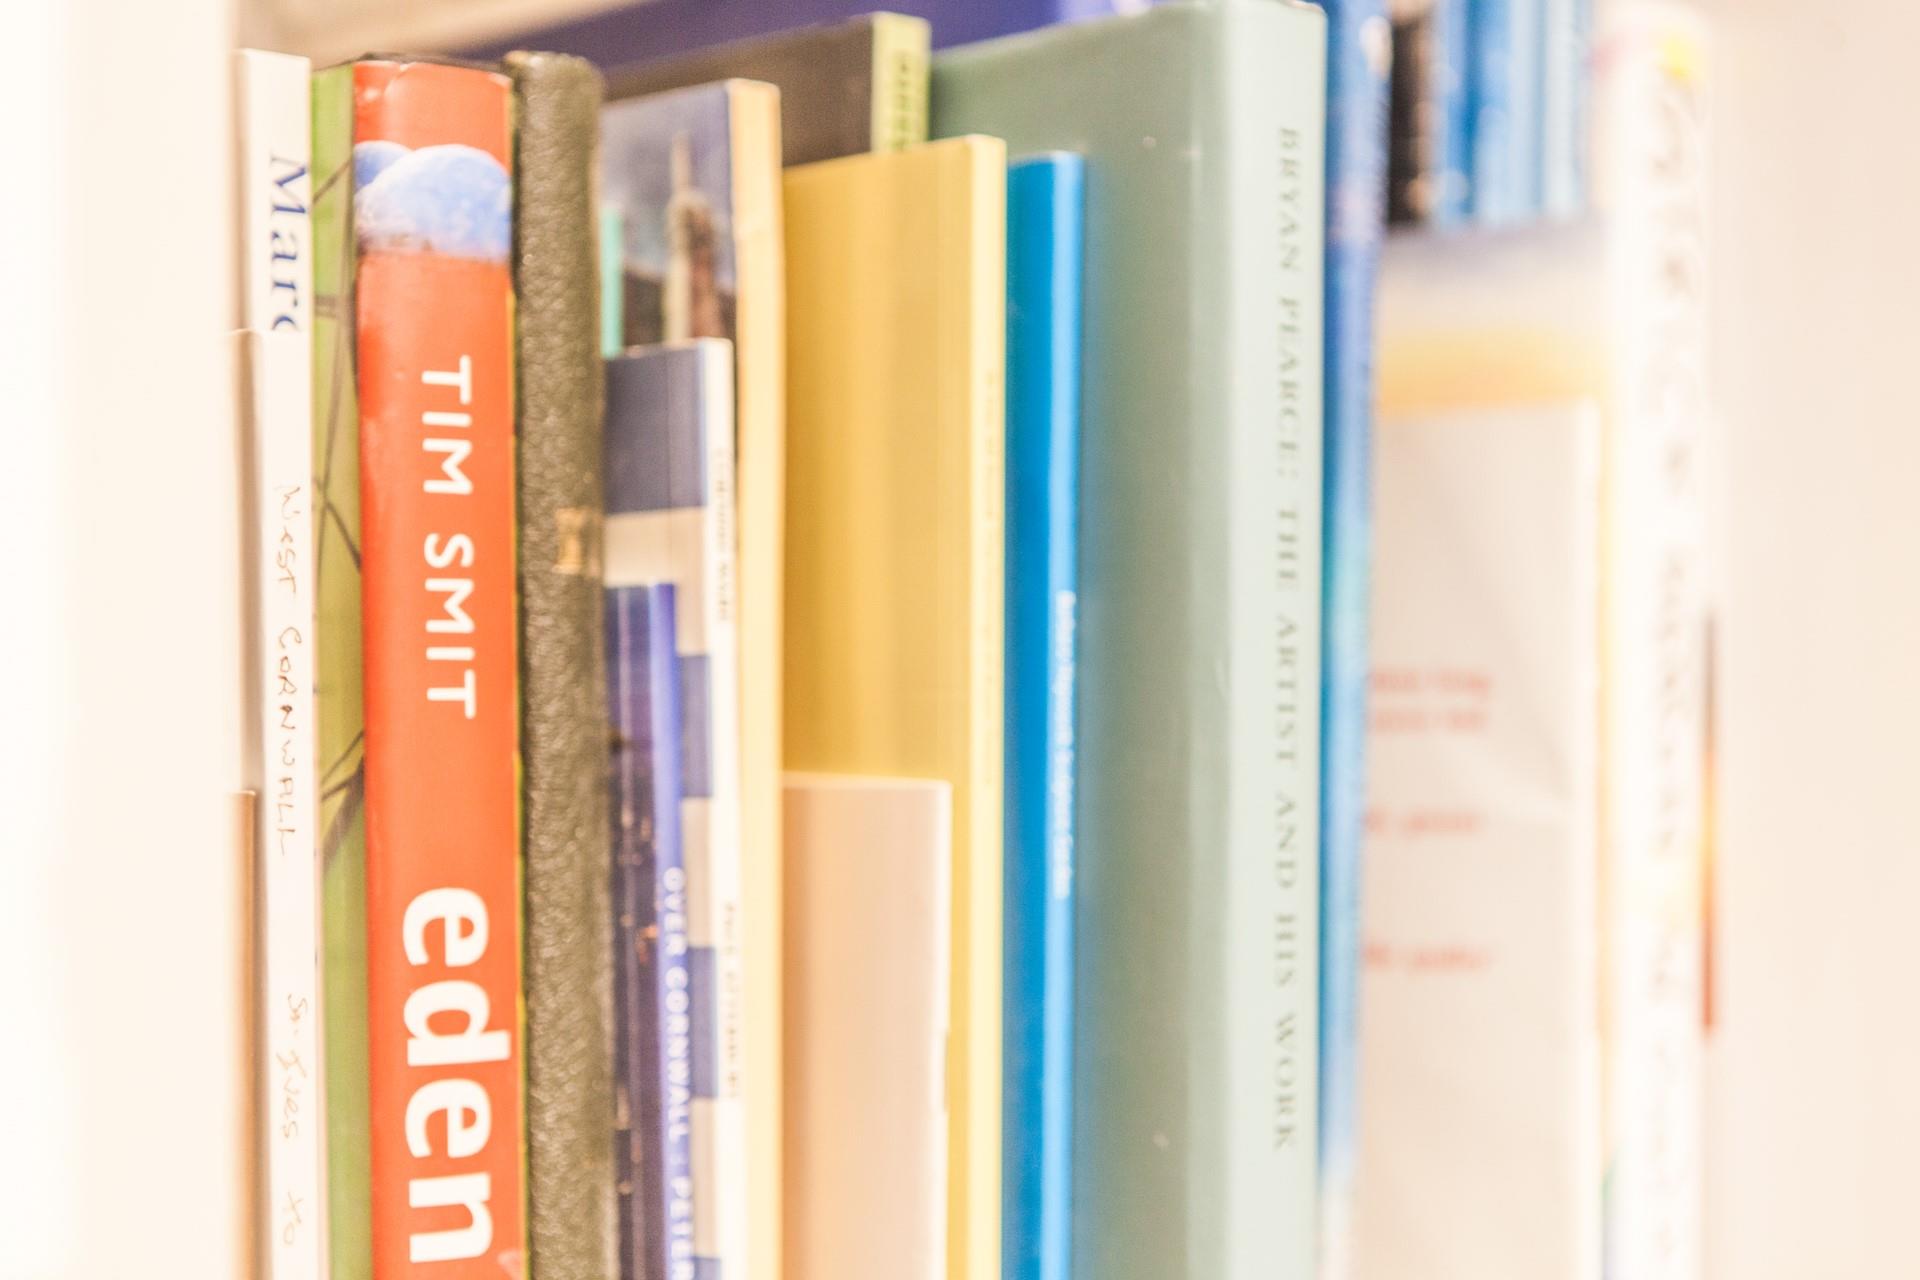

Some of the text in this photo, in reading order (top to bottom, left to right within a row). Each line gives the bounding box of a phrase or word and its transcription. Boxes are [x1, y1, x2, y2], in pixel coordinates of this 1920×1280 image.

[1278, 127, 1301, 272] BRYAN
[421, 354, 477, 720] TIM SMIT
[1277, 502, 1299, 592] THE
[1276, 613, 1298, 771] ARTIST
[1276, 789, 1298, 889] AND
[663, 867, 687, 956] OVER
[1275, 913, 1297, 988] HIS
[402, 887, 511, 1263] eden
[665, 965, 690, 1146] CORNWALL
[1274, 1010, 1296, 1151] WORK
